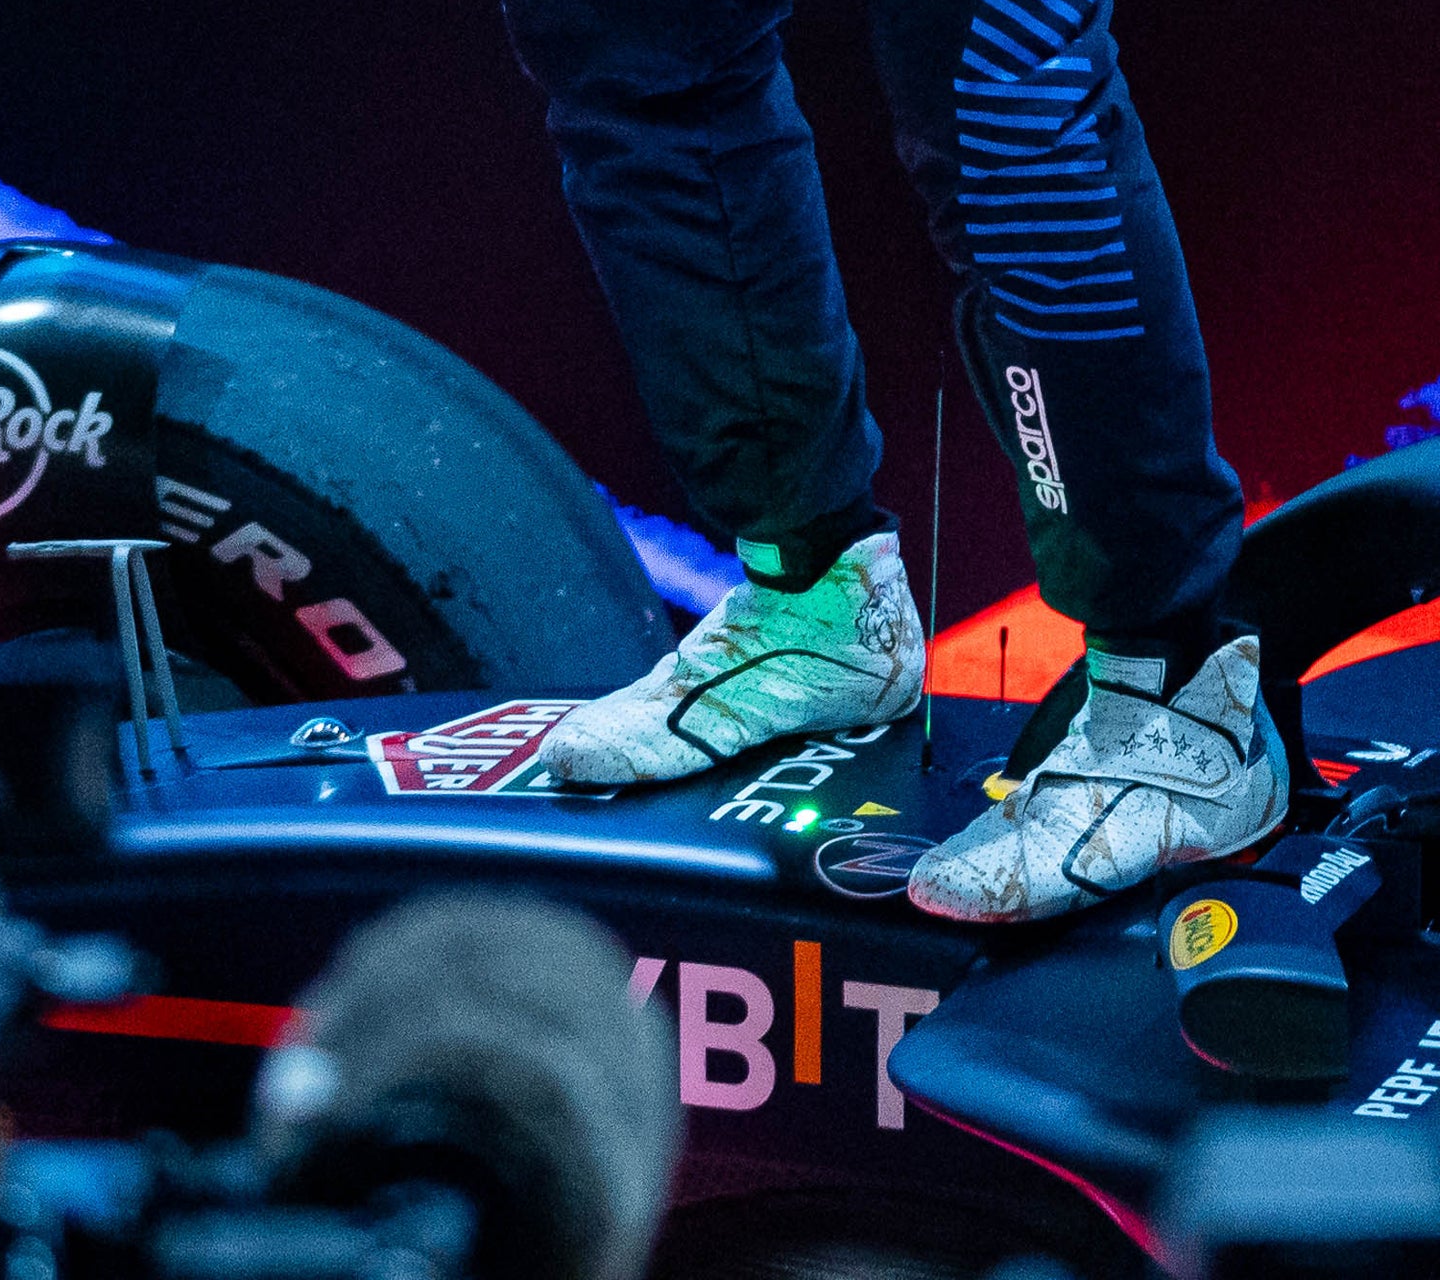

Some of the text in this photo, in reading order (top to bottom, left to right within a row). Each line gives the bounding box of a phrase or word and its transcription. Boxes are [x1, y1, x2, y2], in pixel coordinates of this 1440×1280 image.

[1006, 365, 1066, 511] sparco
[154, 474, 408, 681] ERO
[407, 705, 572, 790] HEUER
[709, 724, 891, 824] ACLE
[626, 940, 940, 1130] BIT
